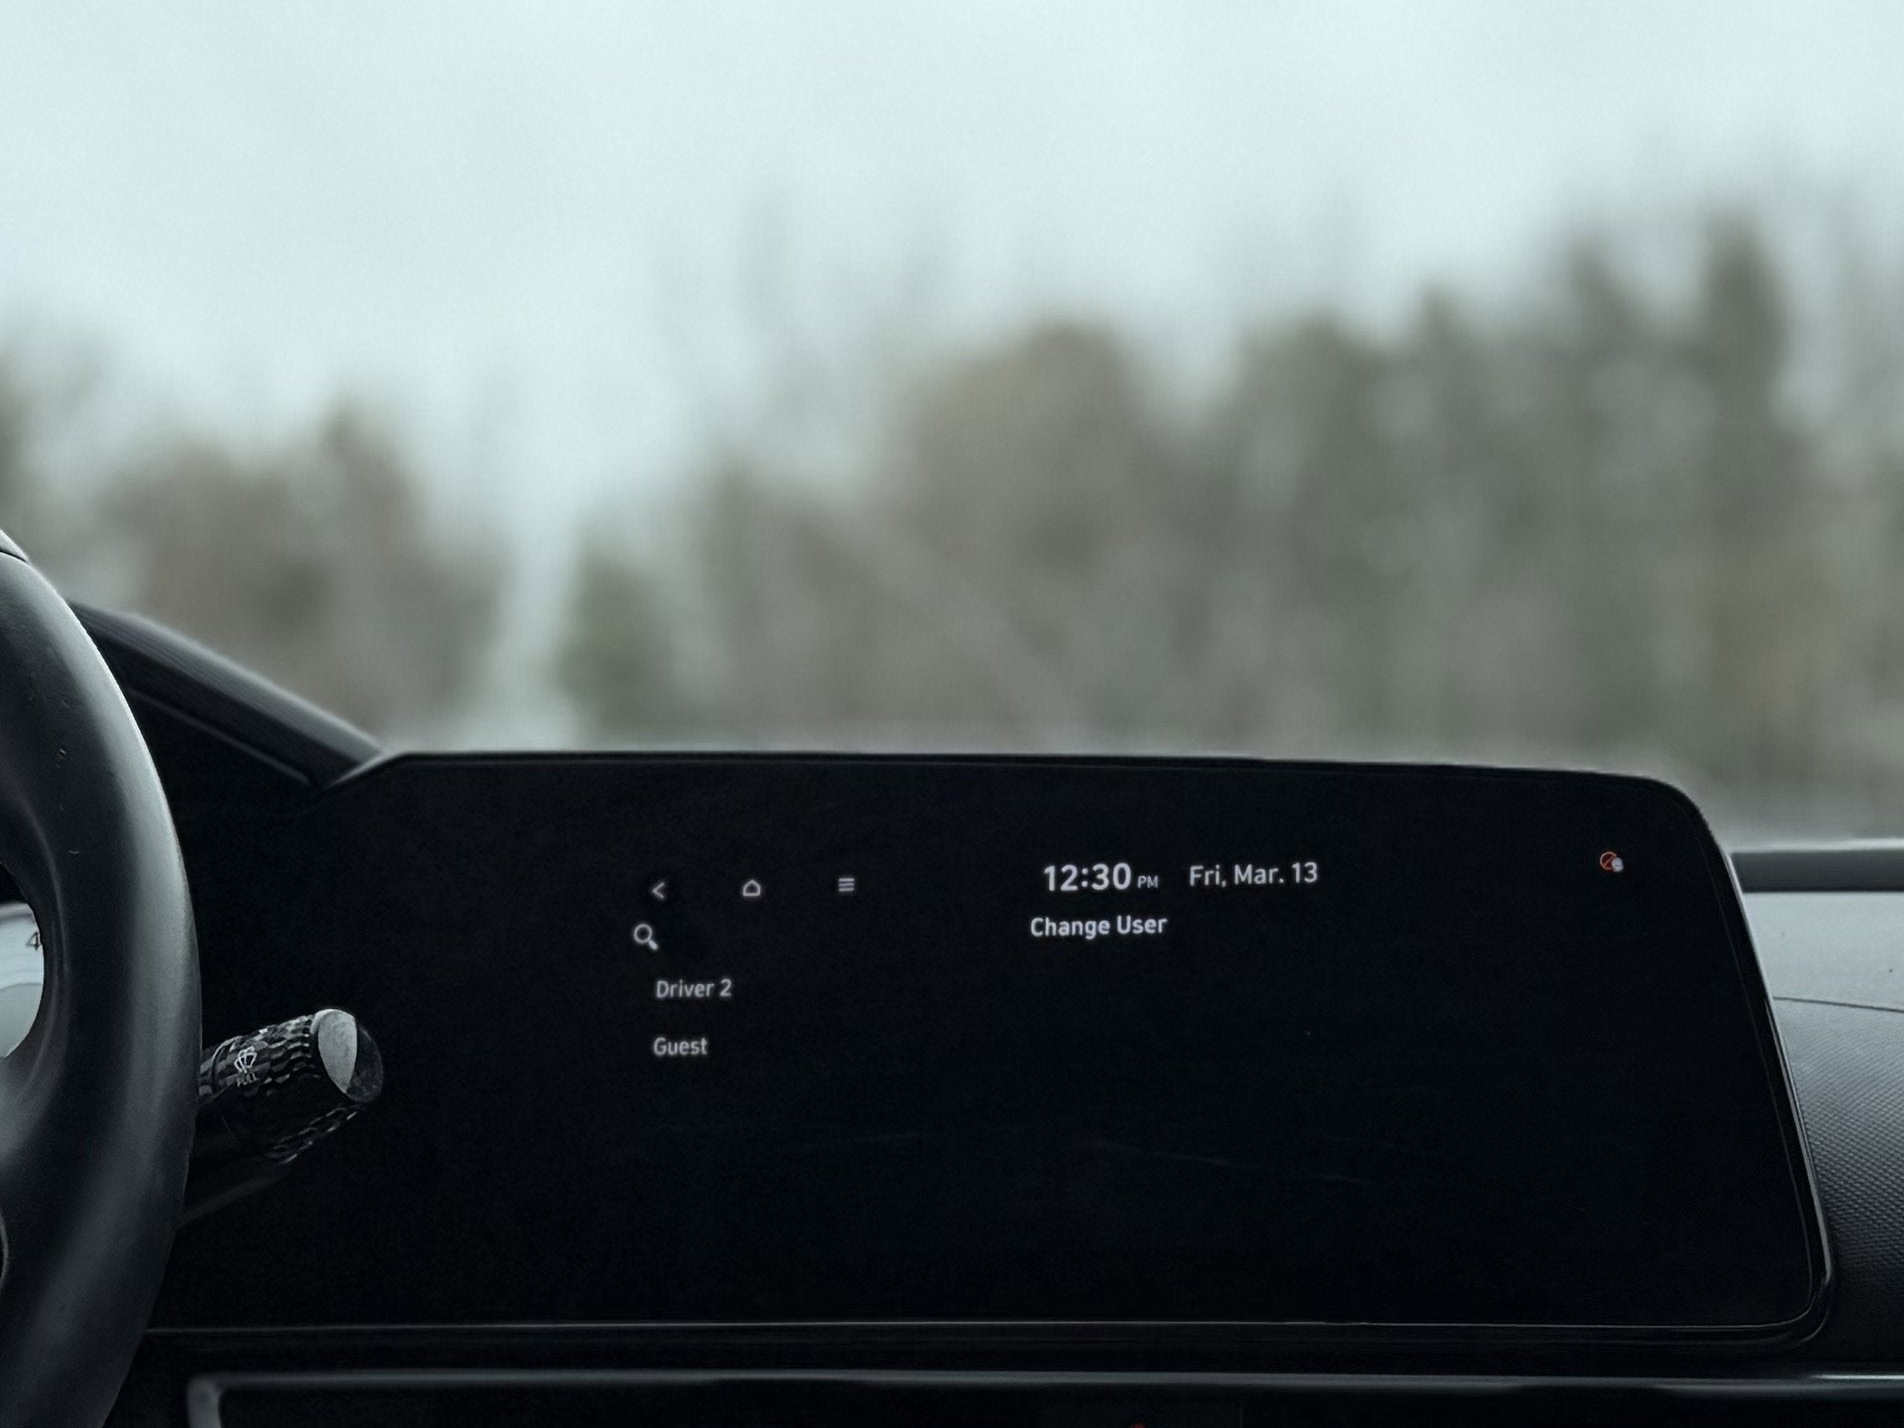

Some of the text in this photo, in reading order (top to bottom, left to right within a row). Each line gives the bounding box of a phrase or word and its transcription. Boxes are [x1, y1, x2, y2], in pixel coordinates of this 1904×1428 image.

[1043, 862, 1133, 892] 12:30
[1137, 875, 1159, 889] PM
[1234, 863, 1285, 885] Mar.
[1292, 861, 1318, 883] 13
[1030, 915, 1168, 940] Change User
[655, 978, 732, 999] Driver 2
[653, 1037, 709, 1057] Guest
